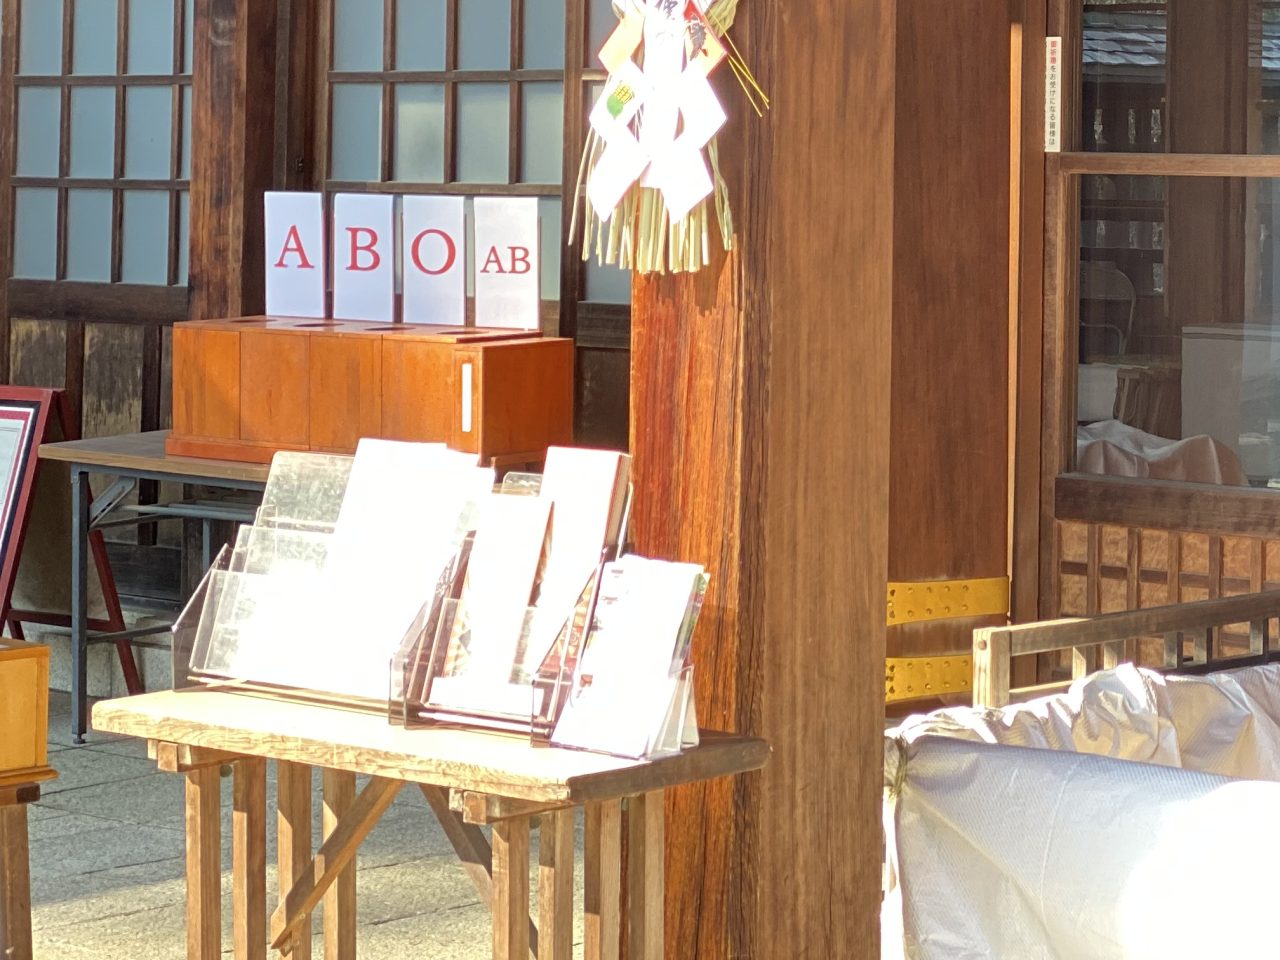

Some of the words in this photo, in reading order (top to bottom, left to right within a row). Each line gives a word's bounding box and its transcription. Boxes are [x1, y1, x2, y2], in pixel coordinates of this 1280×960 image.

[274, 224, 315, 269] A
[345, 227, 381, 271] B
[411, 228, 457, 275] O
[480, 246, 531, 274] AB
